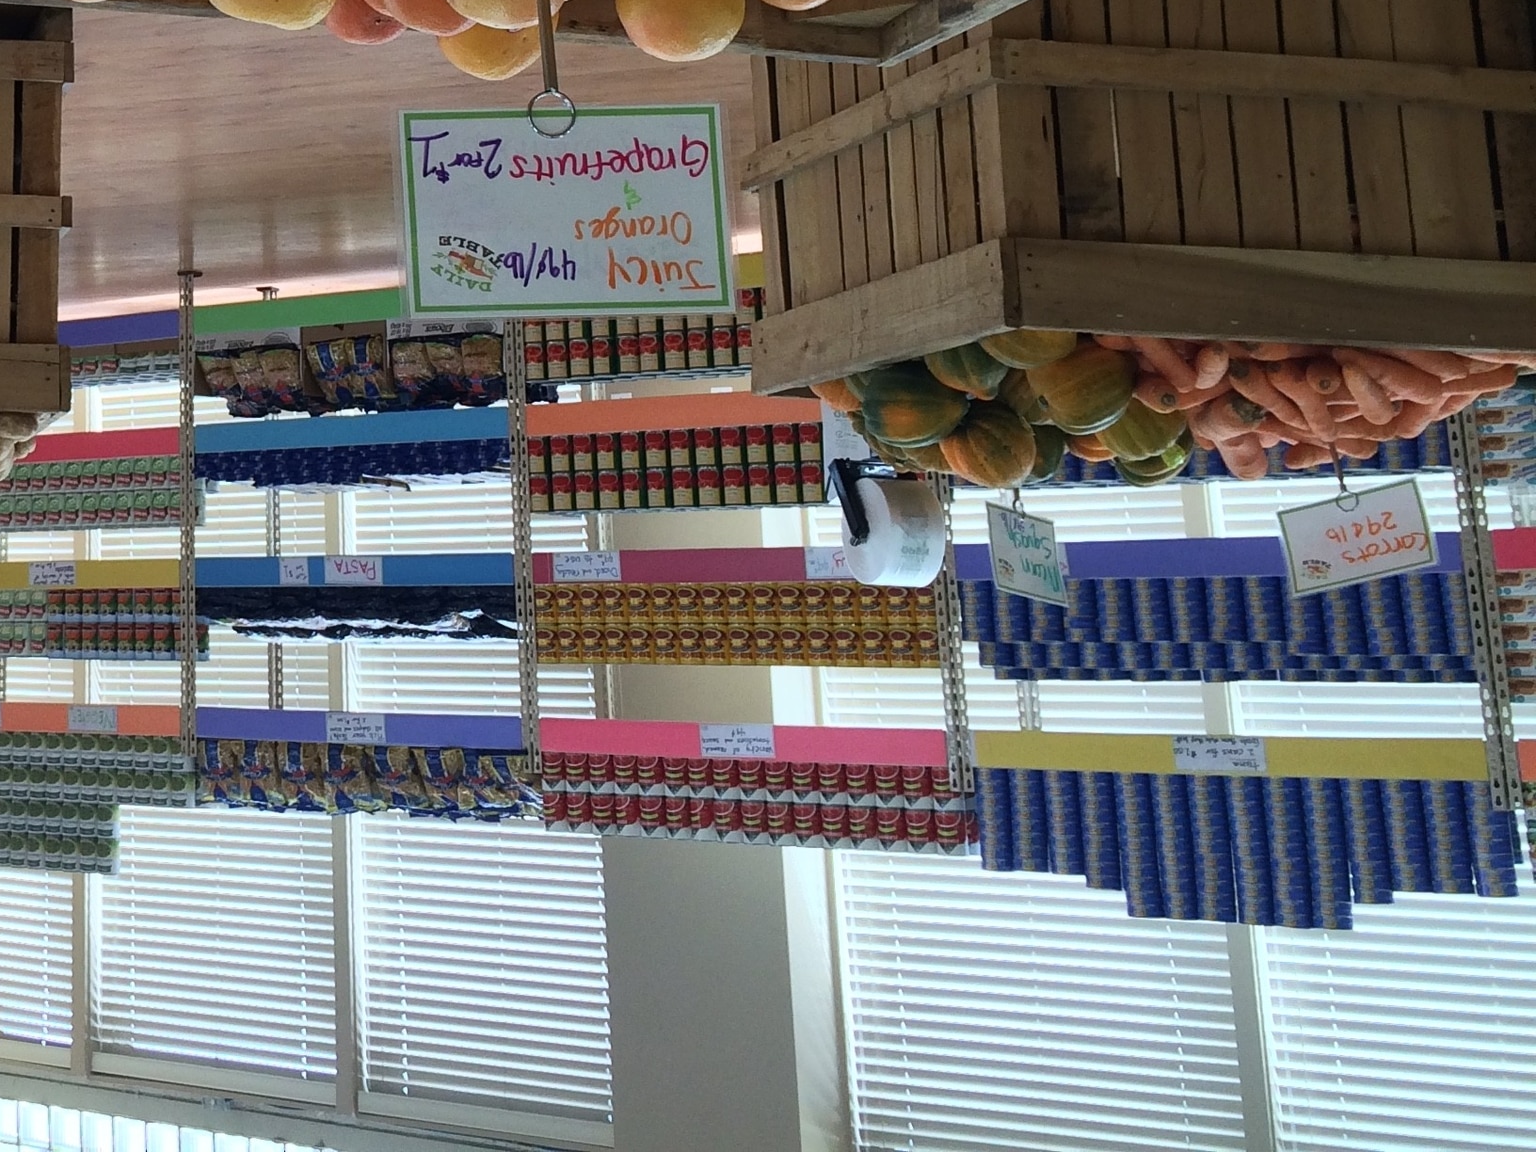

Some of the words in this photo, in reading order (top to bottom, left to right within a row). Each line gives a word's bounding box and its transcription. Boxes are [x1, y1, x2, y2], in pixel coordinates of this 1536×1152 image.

[406, 131, 450, 185] $1
[479, 138, 503, 179] 2
[509, 135, 709, 185] Grapefruits
[574, 207, 692, 245] Oranges
[438, 236, 505, 270] TABLE
[430, 263, 492, 292] DAILY
[333, 559, 376, 581] PASTA
